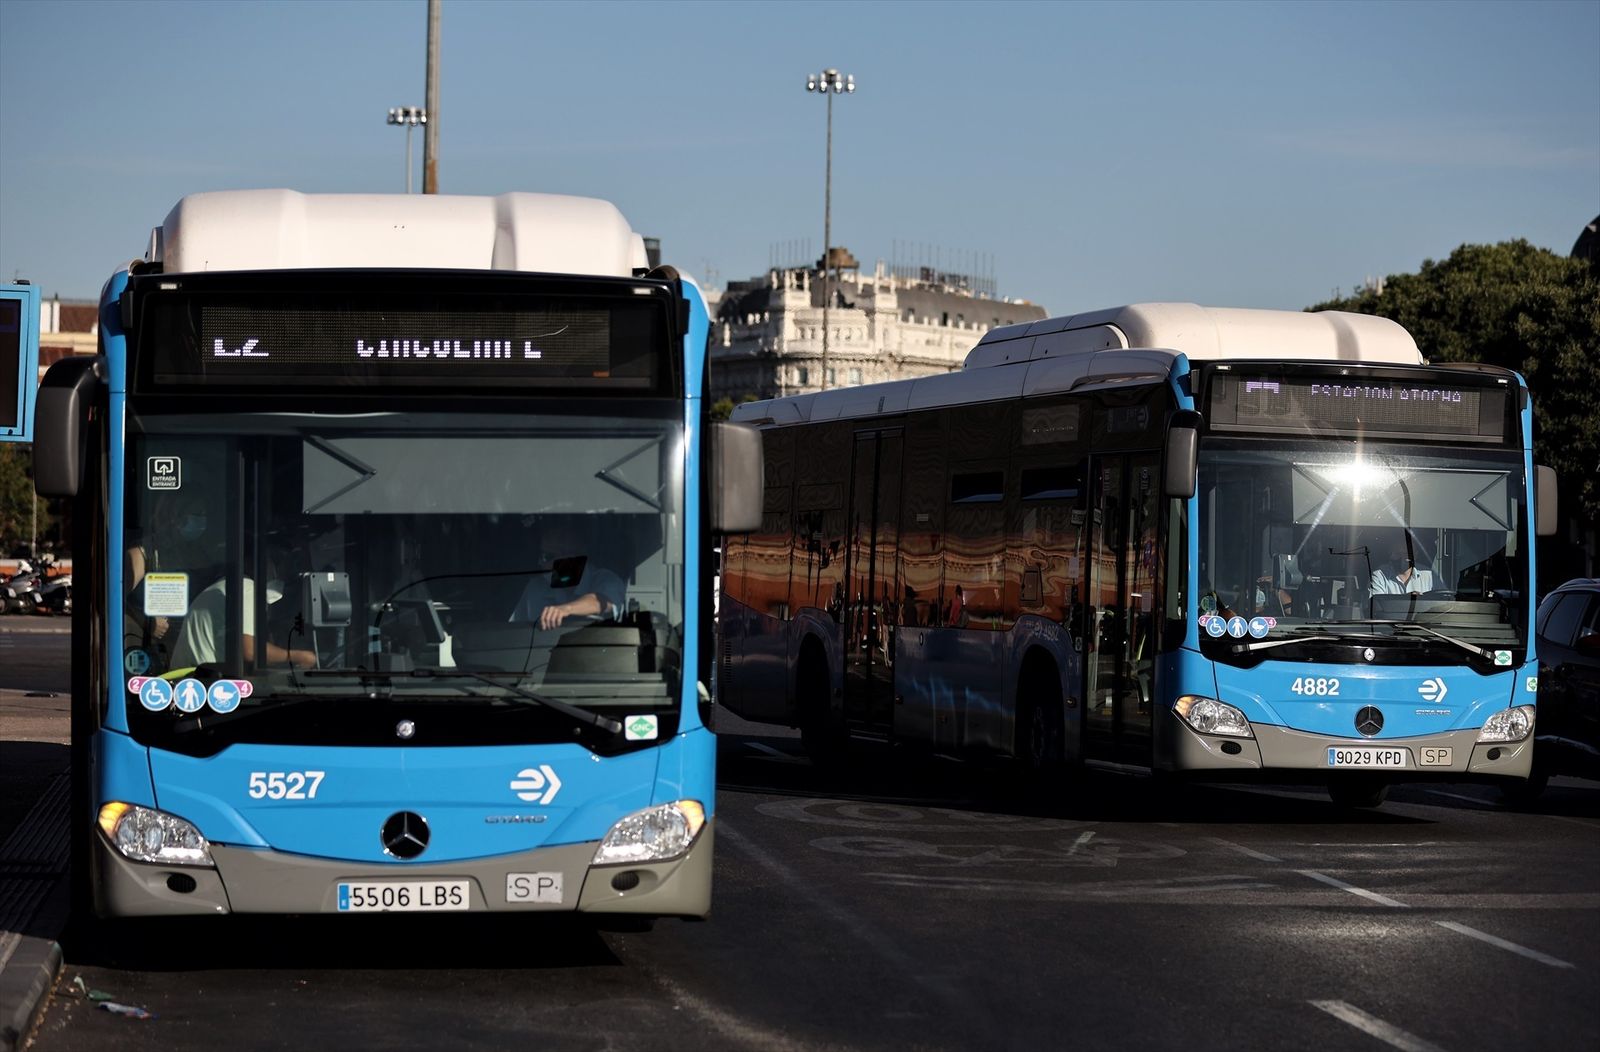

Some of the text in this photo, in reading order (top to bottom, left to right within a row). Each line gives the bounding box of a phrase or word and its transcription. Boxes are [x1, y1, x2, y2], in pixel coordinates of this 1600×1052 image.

[131, 679, 140, 691] 2
[240, 682, 249, 694] 4
[1291, 677, 1340, 696] 4882
[631, 723, 651, 732] GNC
[1335, 750, 1402, 765] 9029 KPD
[1424, 748, 1448, 763] SP
[248, 770, 326, 800] 5527
[513, 876, 554, 898] SP
[352, 885, 463, 908] 5506 LBS
